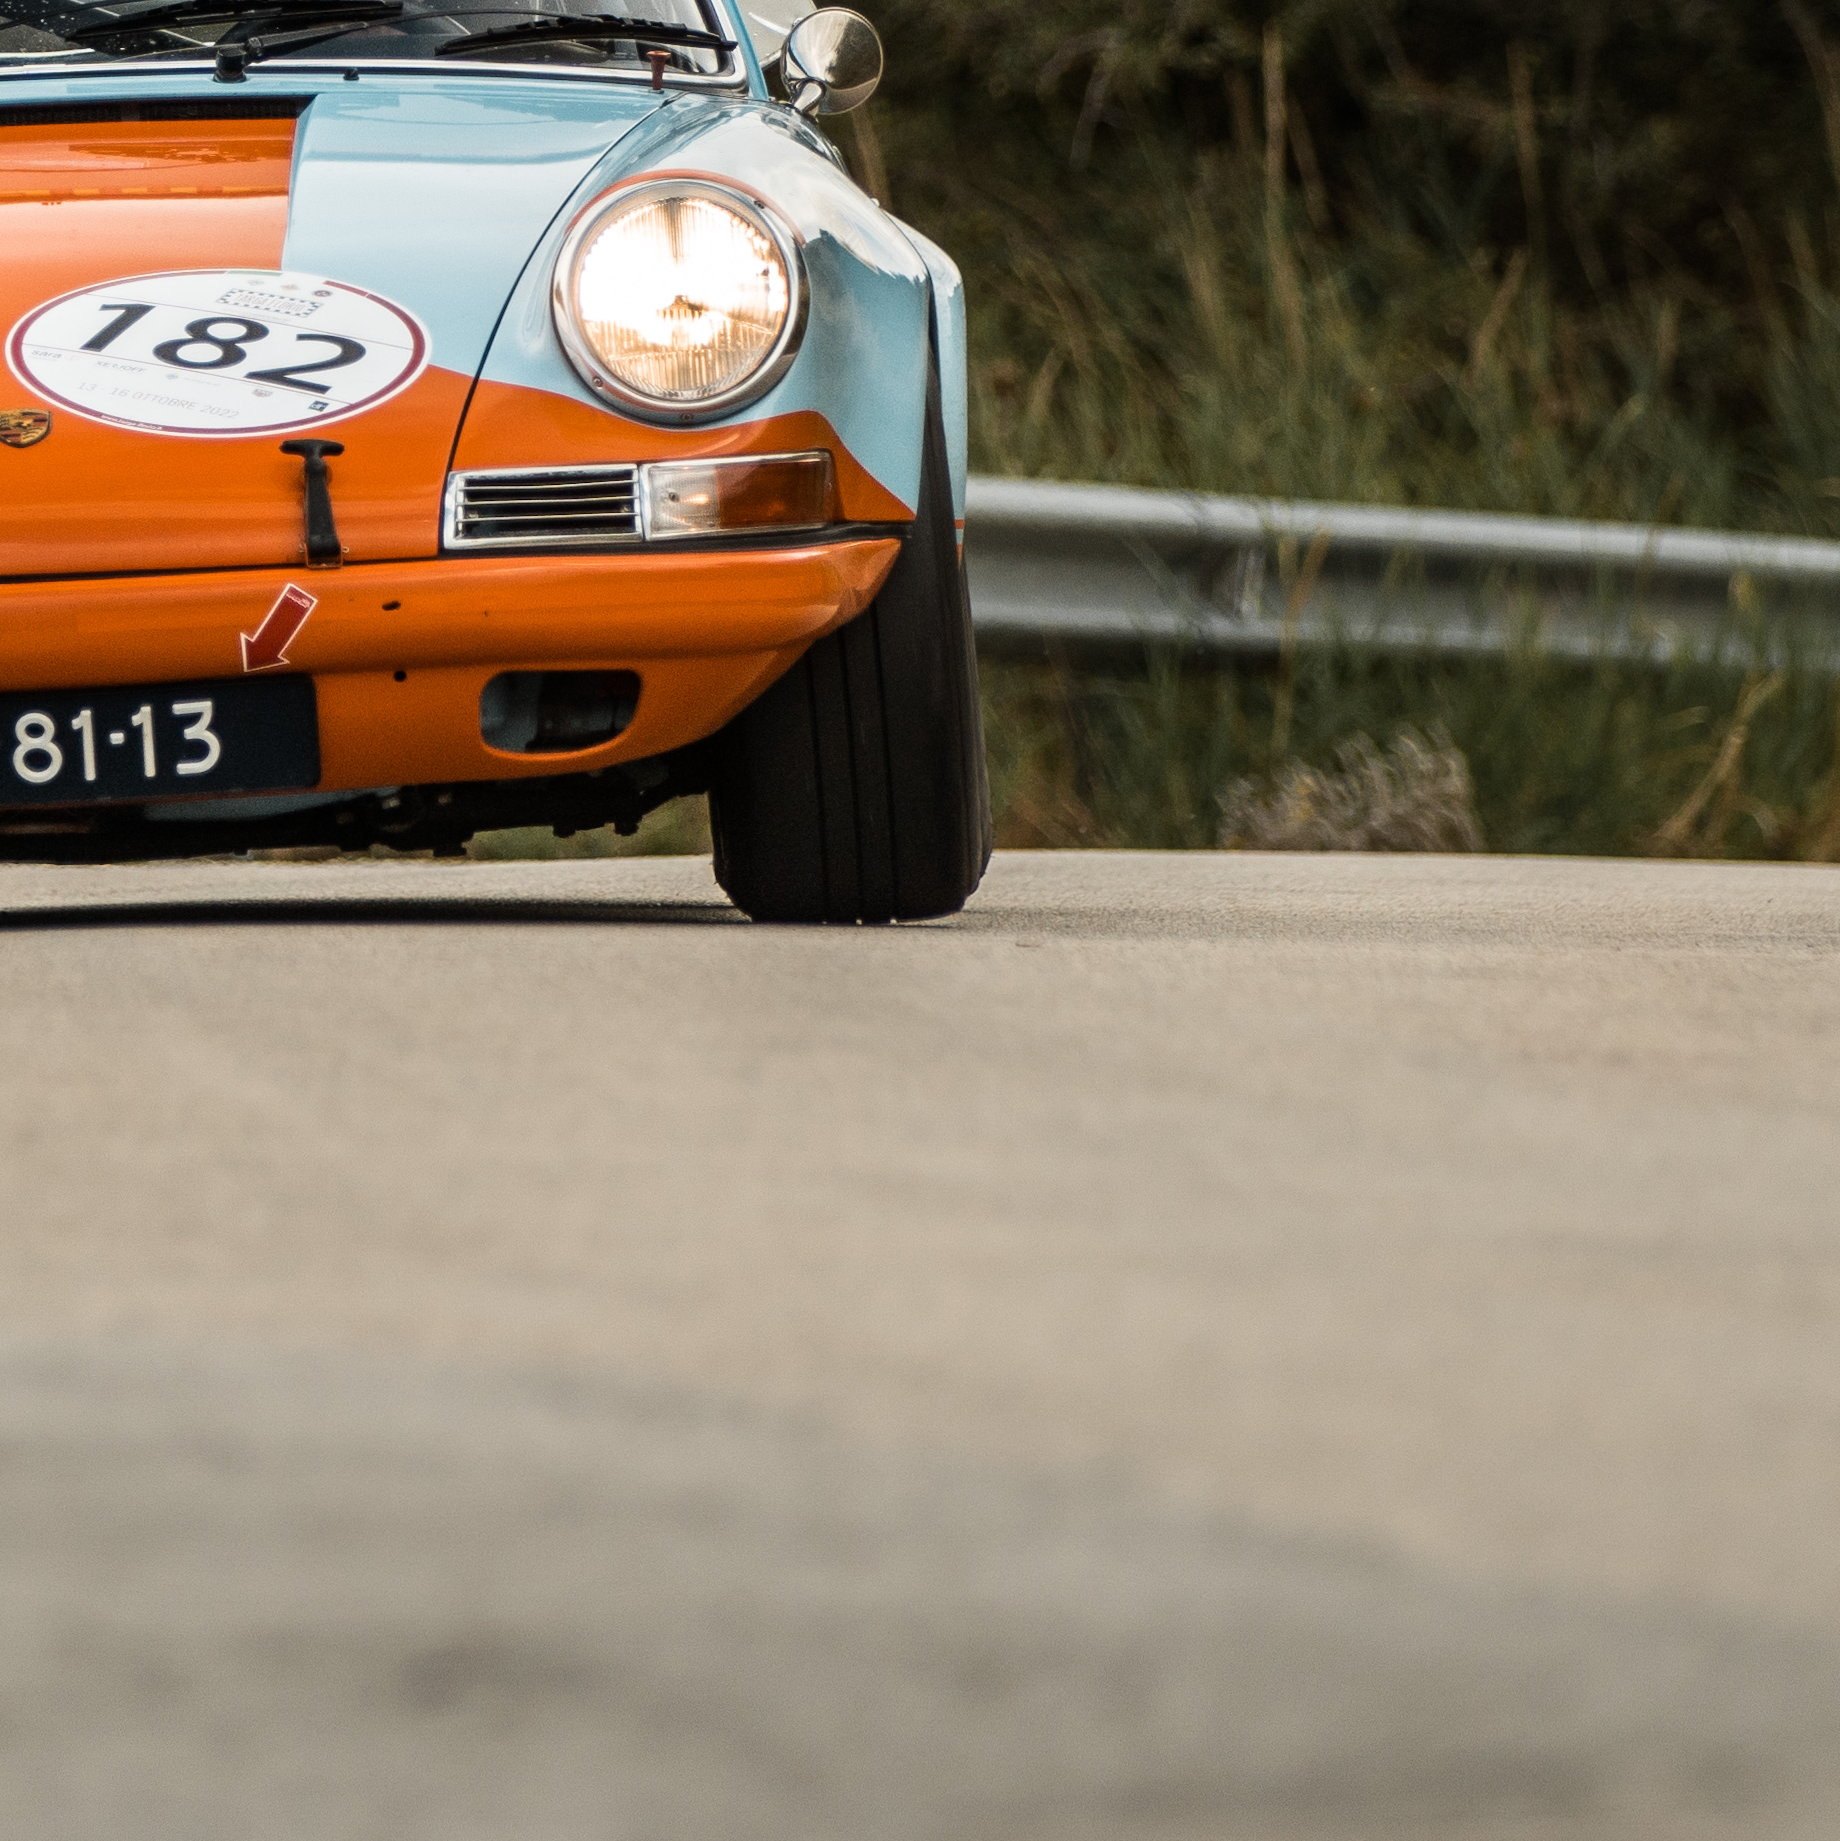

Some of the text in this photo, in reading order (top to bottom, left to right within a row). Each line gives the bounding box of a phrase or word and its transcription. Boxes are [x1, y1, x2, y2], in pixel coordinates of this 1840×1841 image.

[79, 303, 366, 395] 182
[78, 382, 97, 392] 13
[109, 387, 128, 397] 16
[132, 391, 199, 410] OTTOBRE
[200, 404, 240, 418] 2022
